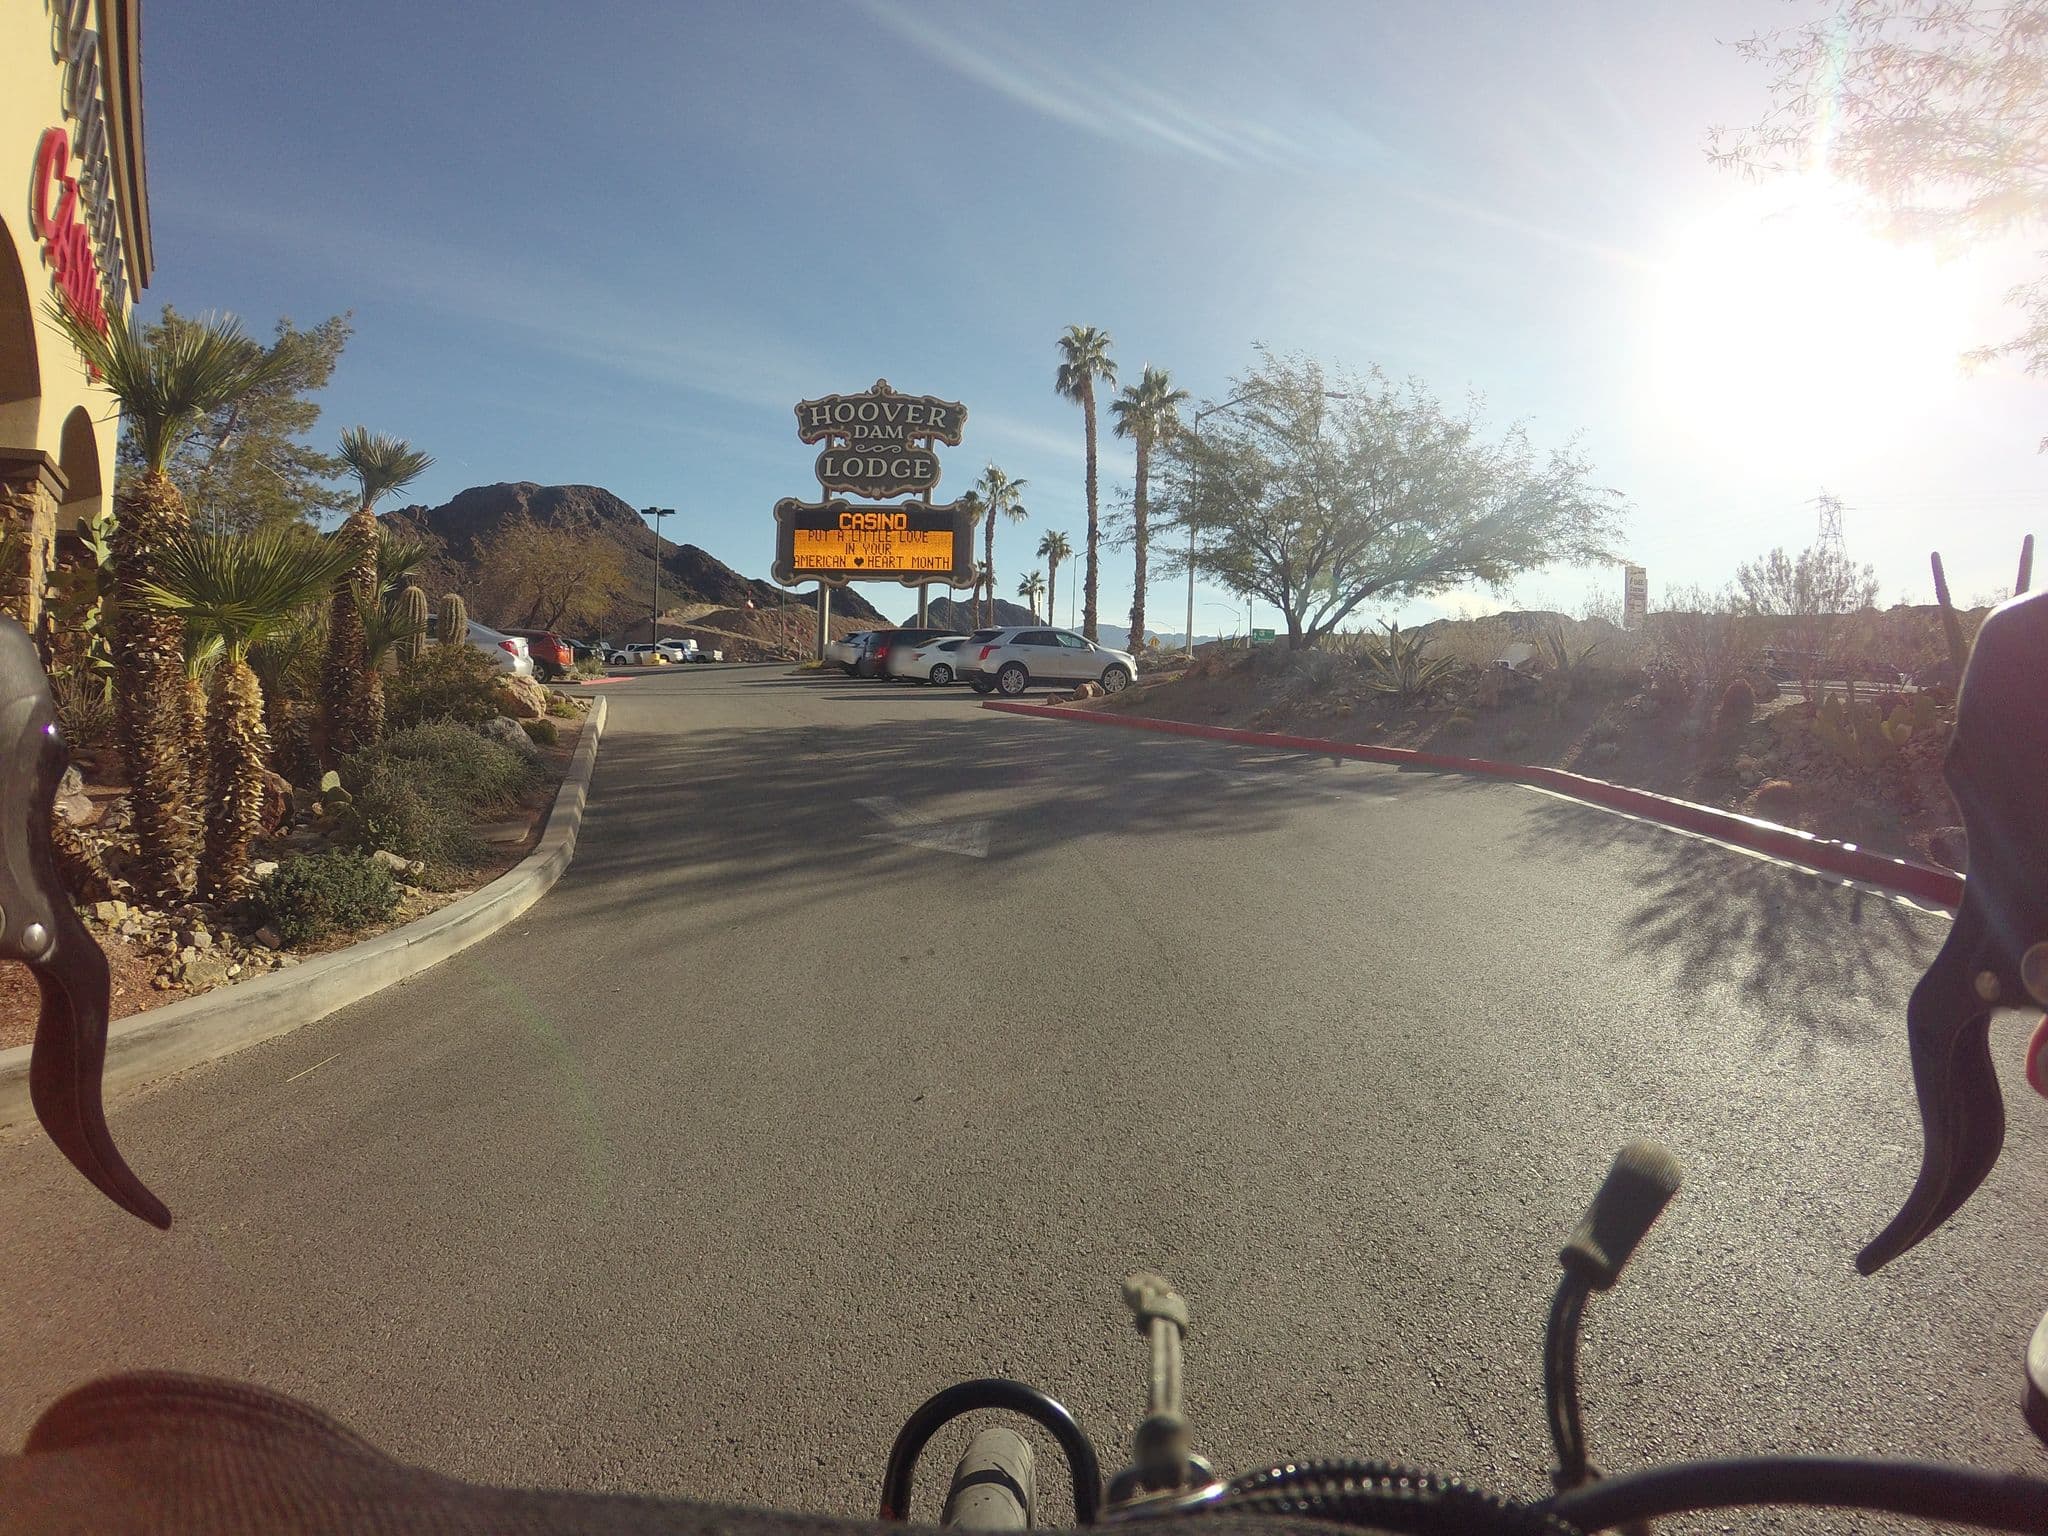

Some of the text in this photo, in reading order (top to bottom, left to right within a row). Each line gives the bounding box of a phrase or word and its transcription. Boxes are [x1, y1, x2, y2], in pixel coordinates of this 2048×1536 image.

[809, 401, 947, 428] HOOVER
[853, 424, 904, 440] DAM
[823, 456, 932, 479] LODGE
[839, 512, 908, 530] CASINO
[851, 531, 892, 543] LITTLE
[899, 532, 928, 543] LOVE
[845, 543, 892, 555] IN YOUR
[794, 555, 950, 569] AMERICAN HEART MONTH
